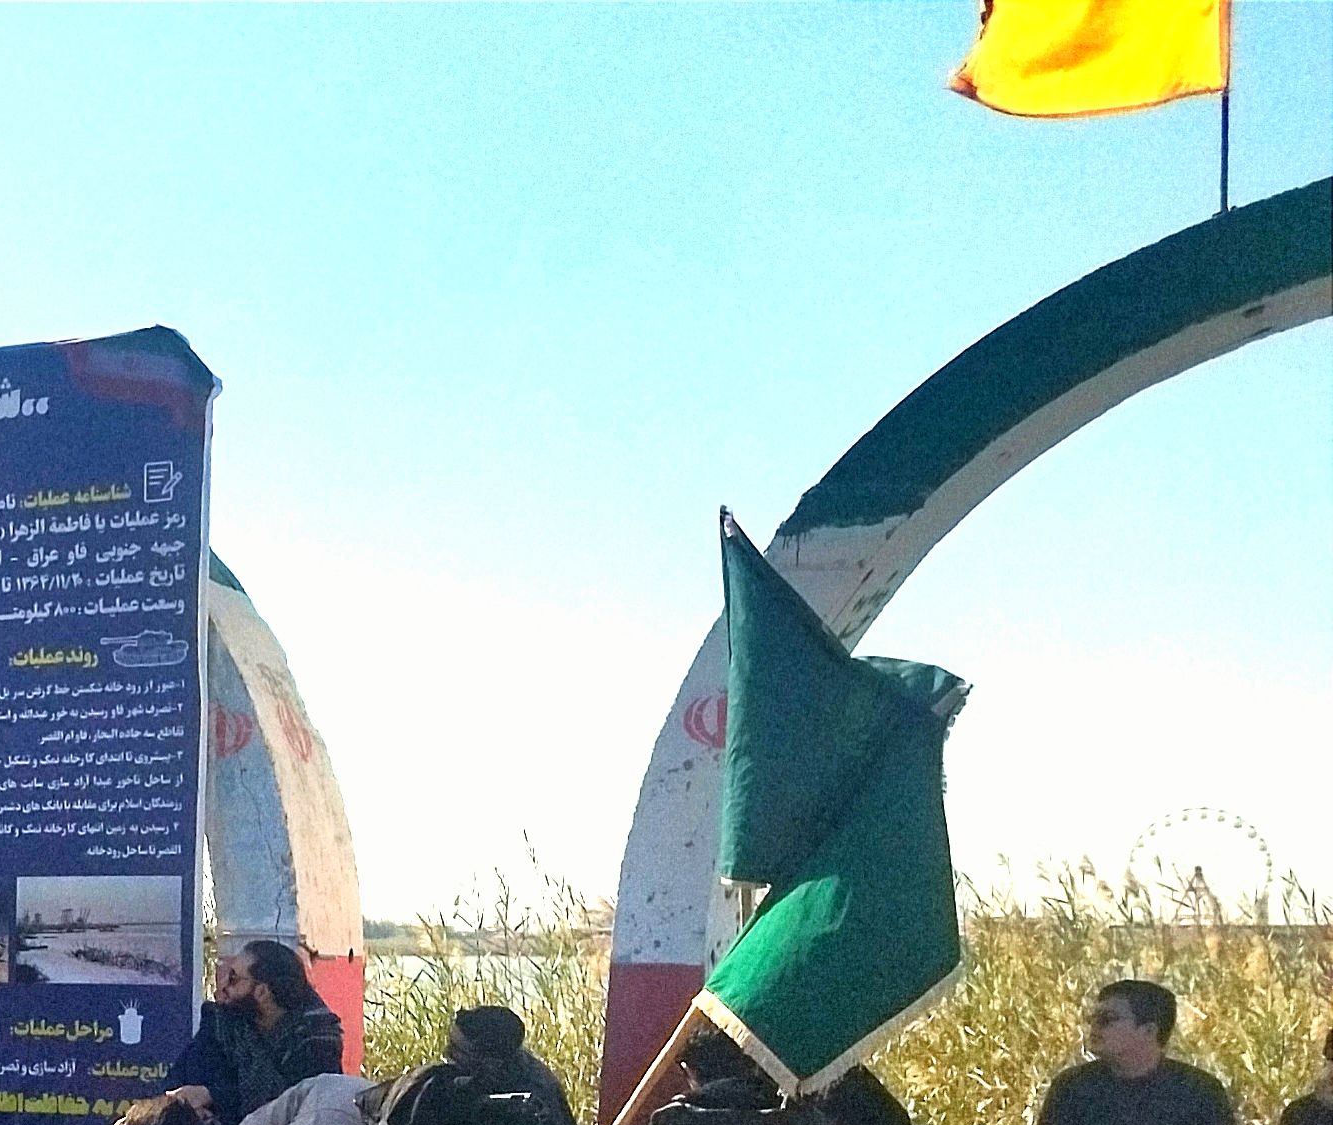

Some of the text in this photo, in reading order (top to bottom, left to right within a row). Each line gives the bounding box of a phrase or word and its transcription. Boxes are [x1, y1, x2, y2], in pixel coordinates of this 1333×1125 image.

[74, 483, 131, 503] شناسنامه
[9, 519, 45, 542] الزهرا
[95, 514, 106, 533] یا
[110, 511, 158, 531] عملیات
[163, 514, 185, 529] رمز
[27, 547, 58, 567] عراق
[67, 544, 87, 565] فاو
[95, 544, 141, 562] جنوبی
[150, 540, 185, 556] جبهه
[1, 577, 11, 592] تا
[95, 569, 144, 588] عملیات
[149, 564, 185, 586] تاریخ
[142, 598, 185, 614] وسعت
[66, 646, 98, 668] روند
[66, 1020, 113, 1042] مراحل
